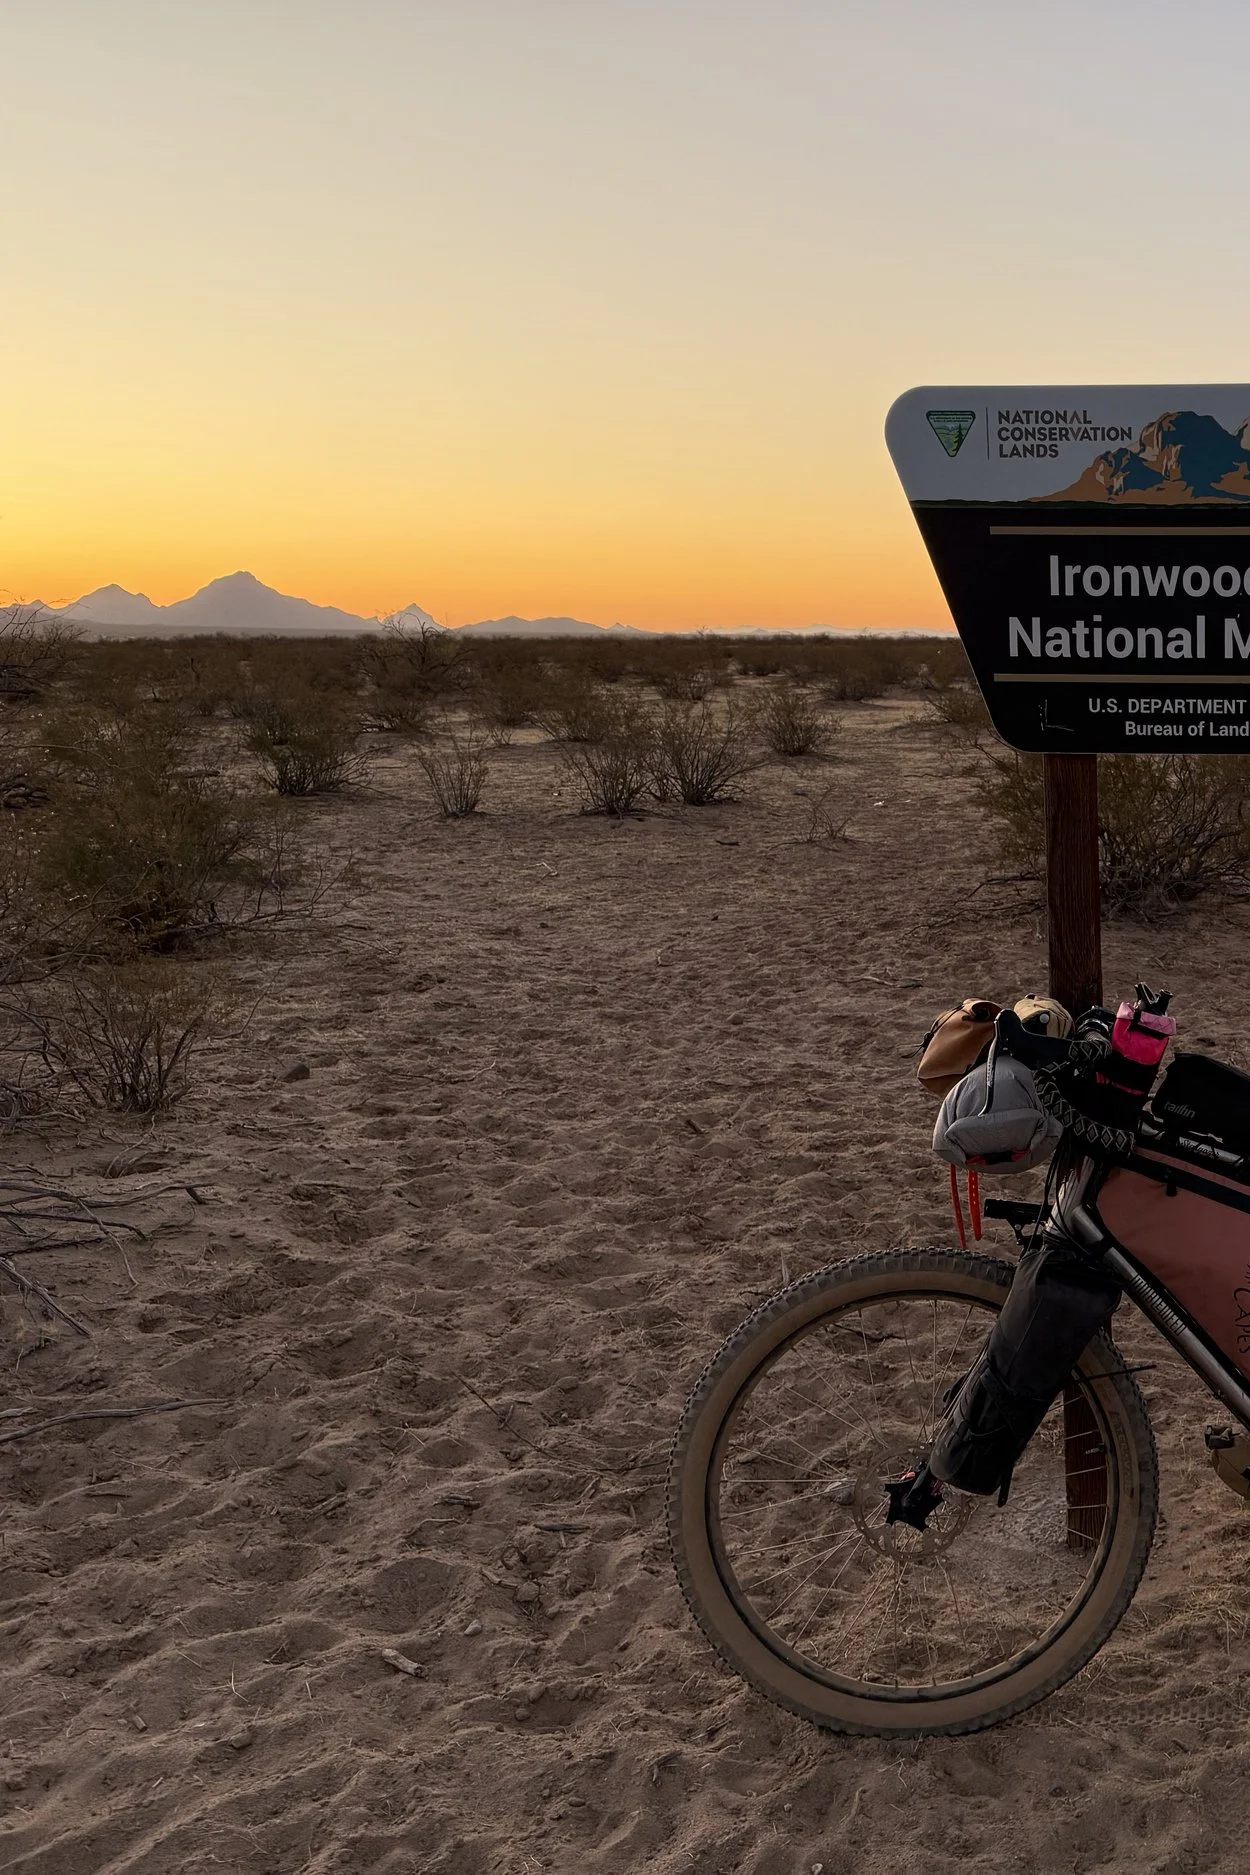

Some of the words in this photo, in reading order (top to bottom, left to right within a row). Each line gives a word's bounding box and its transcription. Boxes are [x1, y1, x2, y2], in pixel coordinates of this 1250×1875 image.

[998, 410, 1092, 425] NATIONAL
[997, 426, 1132, 442] CONSERVATION
[999, 443, 1059, 458] LANDS
[1008, 614, 1206, 659] National
[1088, 698, 1122, 714] U.S.
[1127, 698, 1247, 714] DEPARTMENT
[1125, 721, 1183, 737] Bureau
[1187, 721, 1206, 737] of
[1209, 721, 1250, 737] Land
